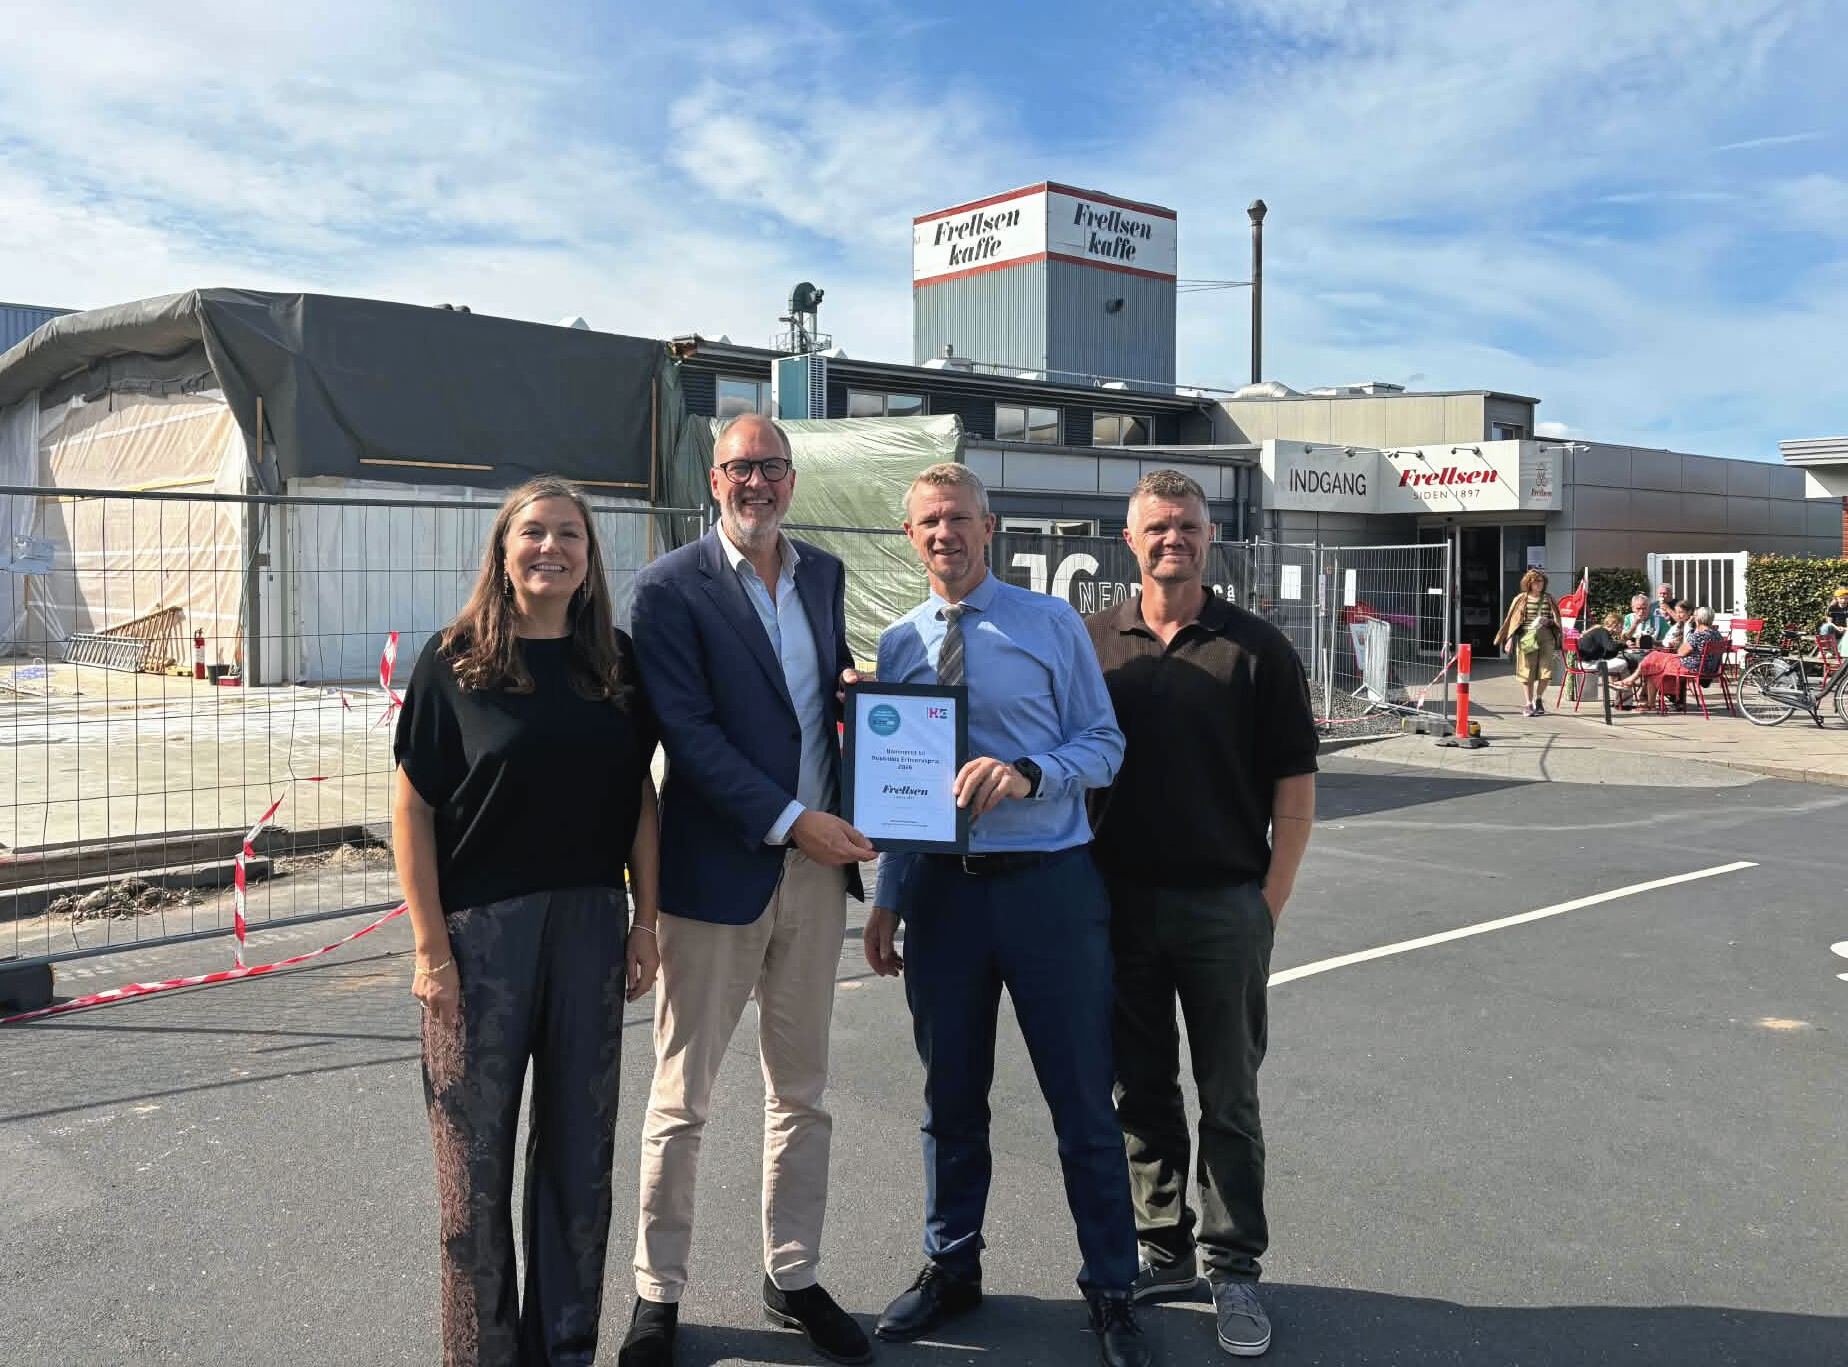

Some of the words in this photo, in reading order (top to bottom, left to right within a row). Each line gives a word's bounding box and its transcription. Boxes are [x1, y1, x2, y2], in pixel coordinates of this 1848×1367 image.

[933, 208, 1020, 247] Frellsen
[1073, 202, 1152, 240] Frellsen
[948, 235, 1002, 266] kaffe
[1088, 232, 1137, 262] kaffe
[1289, 468, 1367, 496] INDGANG
[1398, 466, 1498, 488] Frellsen
[1413, 490, 1448, 501] SIDEN
[1454, 489, 1481, 499] 1897
[882, 784, 929, 796] Frellsen
